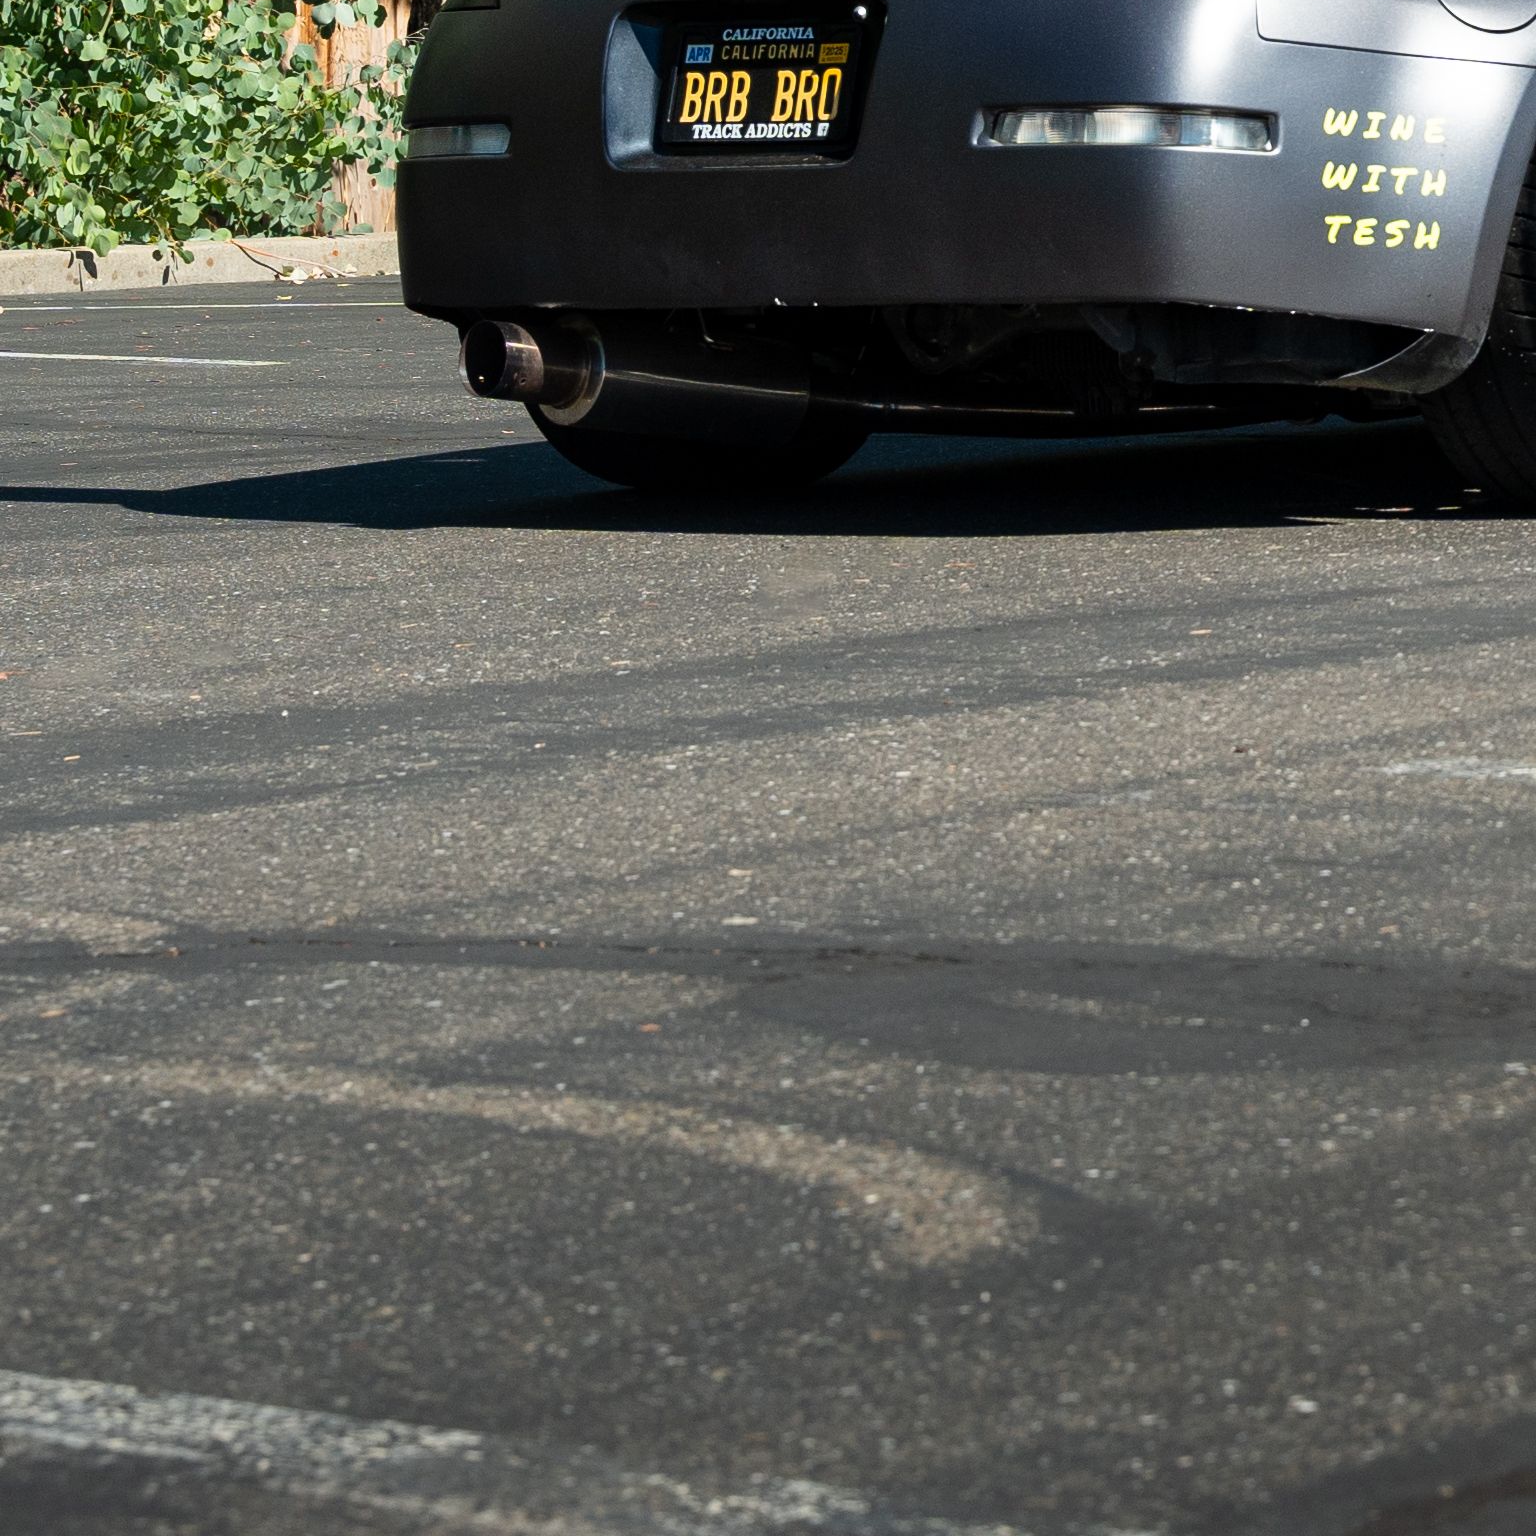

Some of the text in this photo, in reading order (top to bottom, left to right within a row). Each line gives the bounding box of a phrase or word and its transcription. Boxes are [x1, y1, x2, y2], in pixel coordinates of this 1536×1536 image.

[723, 27, 814, 41] CALIFORNIA
[688, 46, 711, 62] APR
[721, 43, 815, 60] CALIFORNIA
[679, 68, 842, 123] BRB BRO
[692, 123, 812, 139] TRACK ADDICTS
[1322, 107, 1447, 144] WINE
[1321, 160, 1448, 197] WITH
[1324, 215, 1441, 250] TESH
